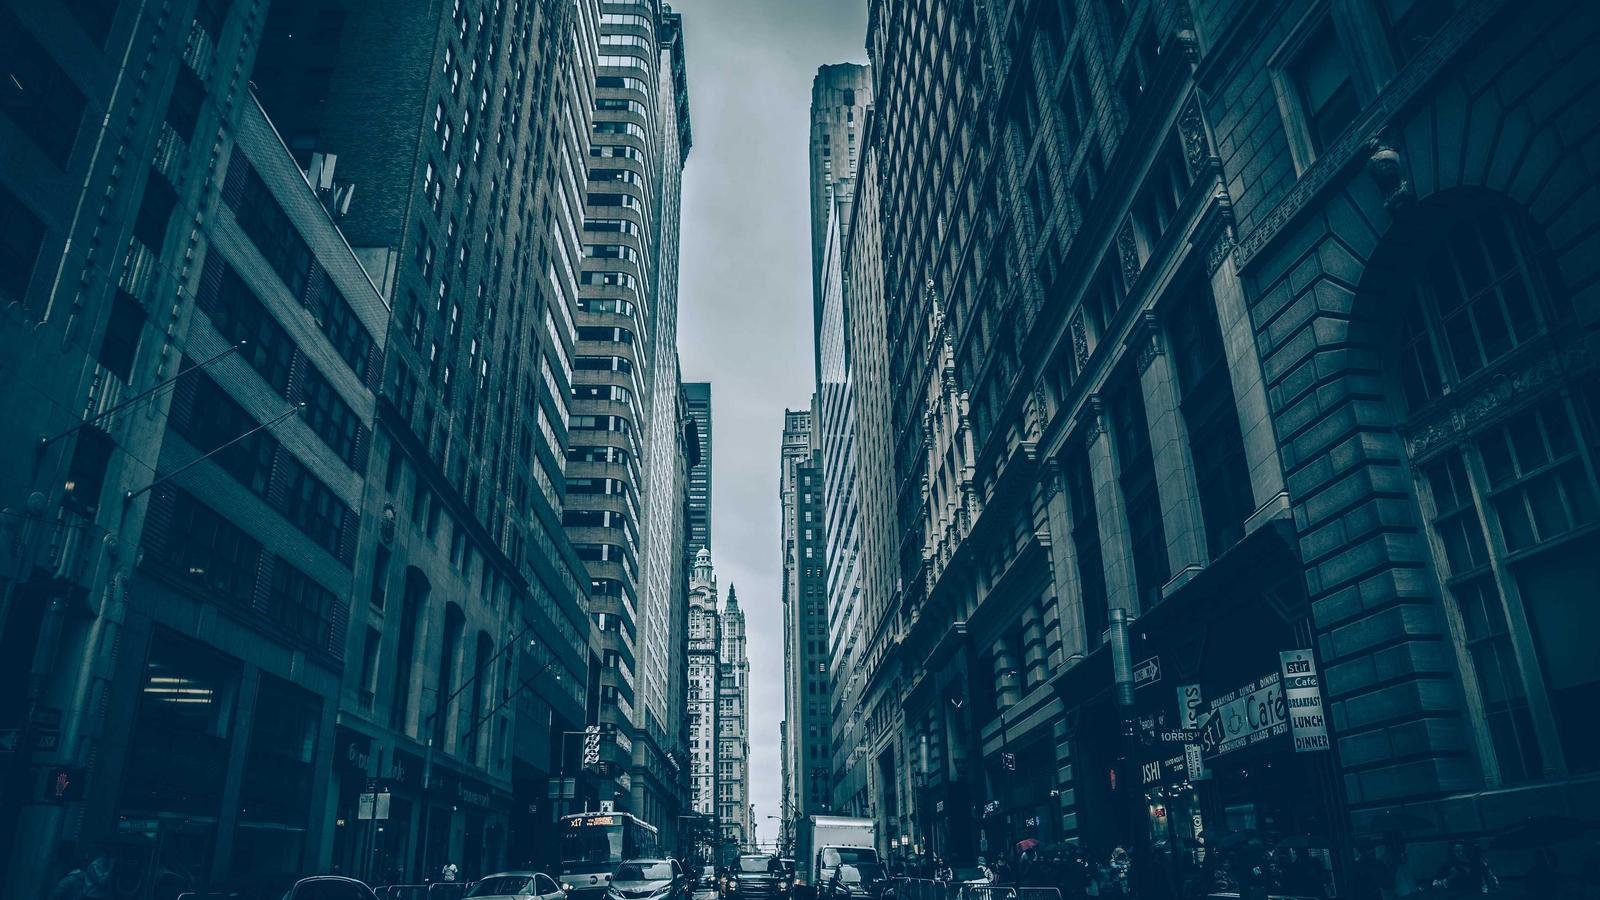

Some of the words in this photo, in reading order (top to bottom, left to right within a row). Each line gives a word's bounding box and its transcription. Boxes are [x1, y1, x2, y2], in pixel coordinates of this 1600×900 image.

[1288, 662, 1307, 673] stir
[1211, 692, 1235, 709] BREAKFAST
[1239, 683, 1256, 697] LUNCH
[1259, 672, 1280, 688] DINNER
[1185, 687, 1200, 730] SUS
[1288, 696, 1321, 709] BREAKFAST
[1203, 717, 1222, 753] str
[1246, 691, 1286, 729] Café
[1293, 715, 1324, 728] LUNCH
[1218, 737, 1247, 754] SANDWICHES
[1250, 729, 1269, 744] SALADS
[1296, 735, 1328, 749] DINNER
